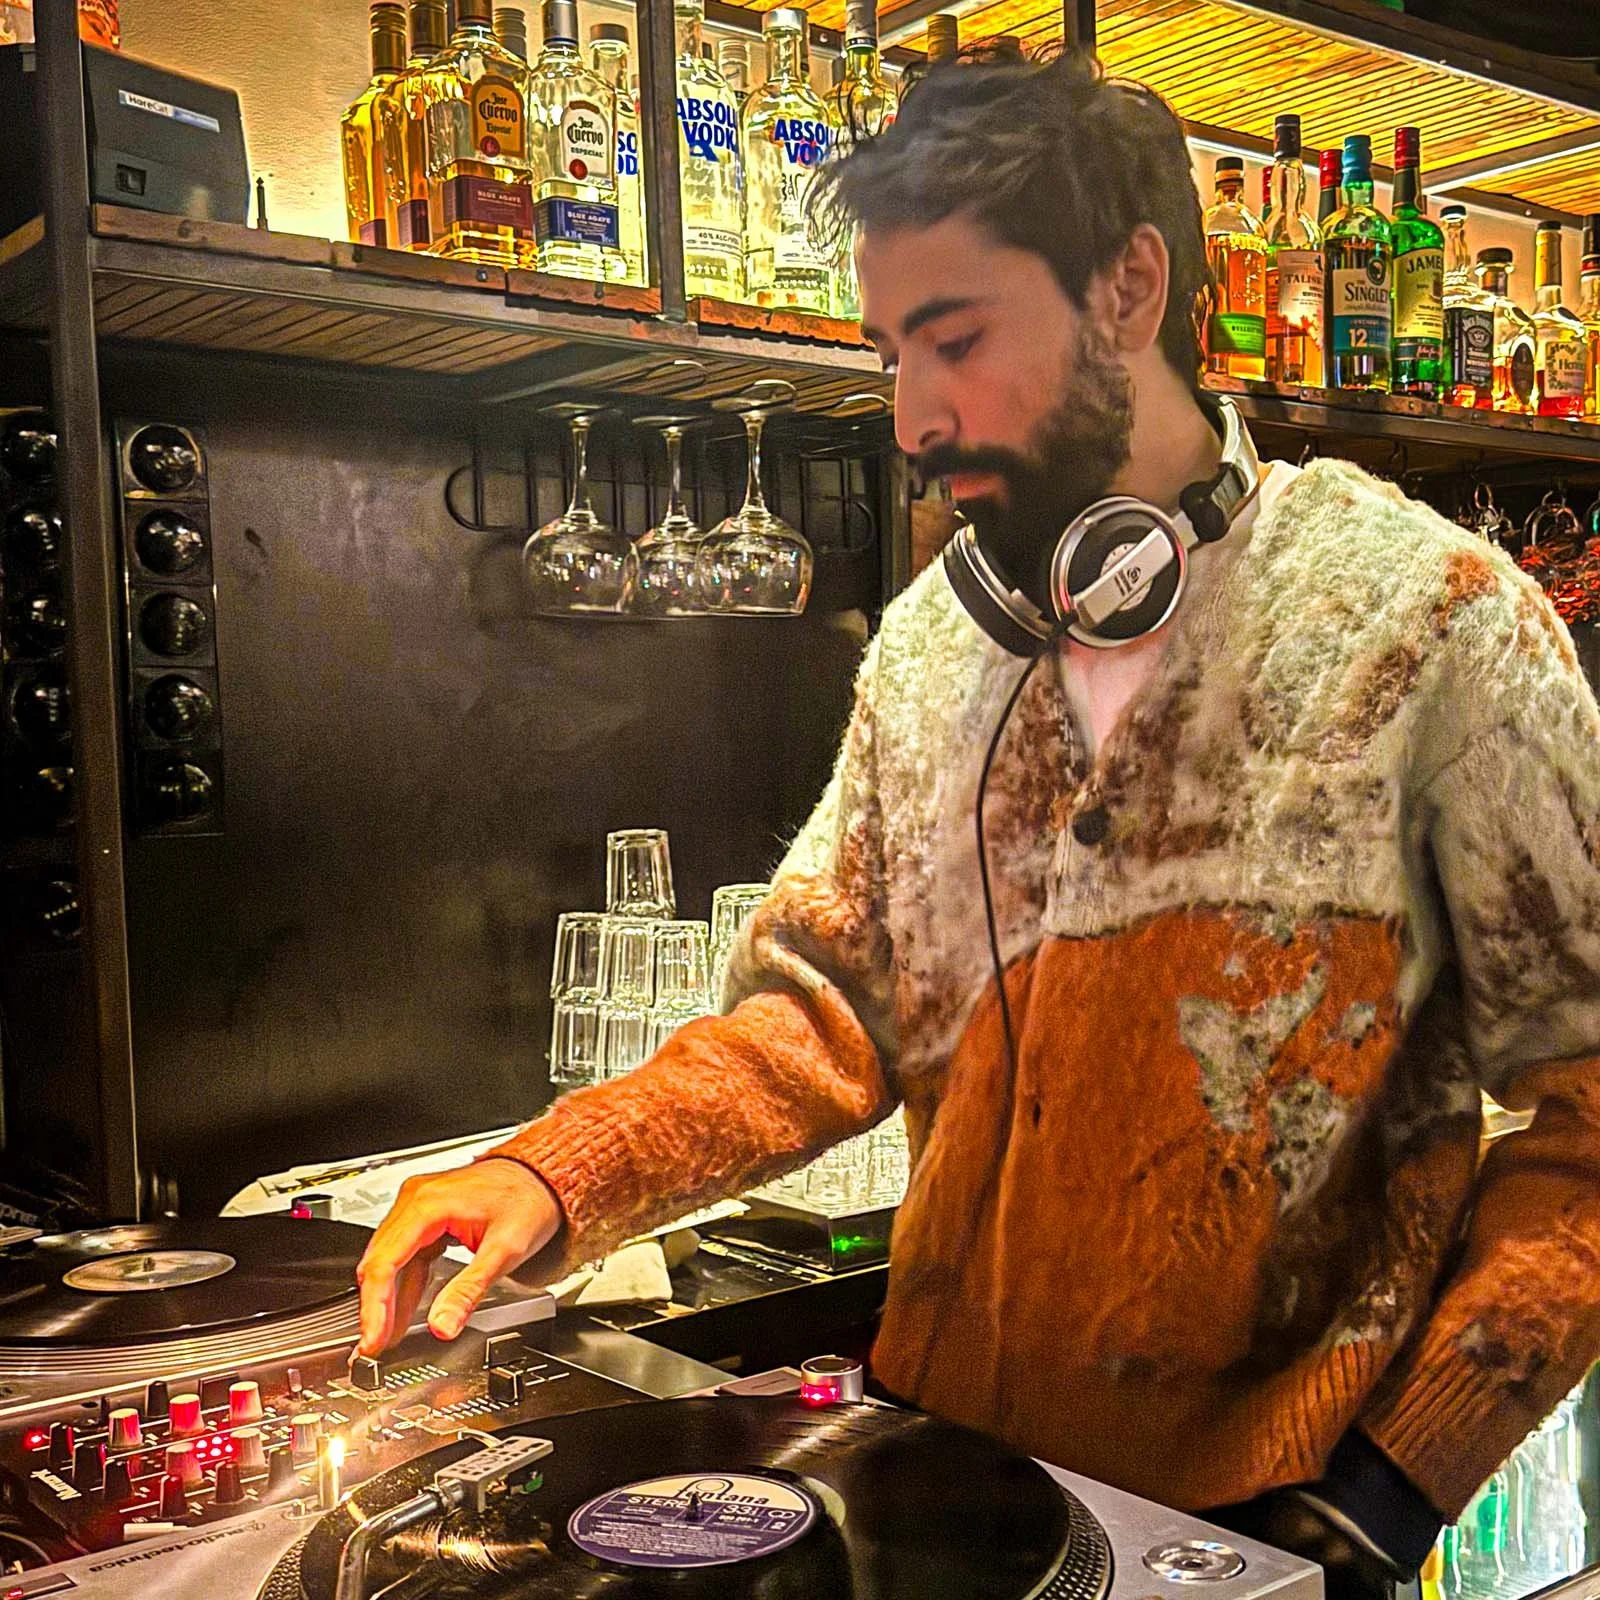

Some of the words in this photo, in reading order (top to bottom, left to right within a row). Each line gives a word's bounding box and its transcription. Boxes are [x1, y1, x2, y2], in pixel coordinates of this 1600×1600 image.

[479, 98, 518, 122] Cuervo
[567, 123, 604, 146] Cuervo
[1349, 328, 1368, 348] 12
